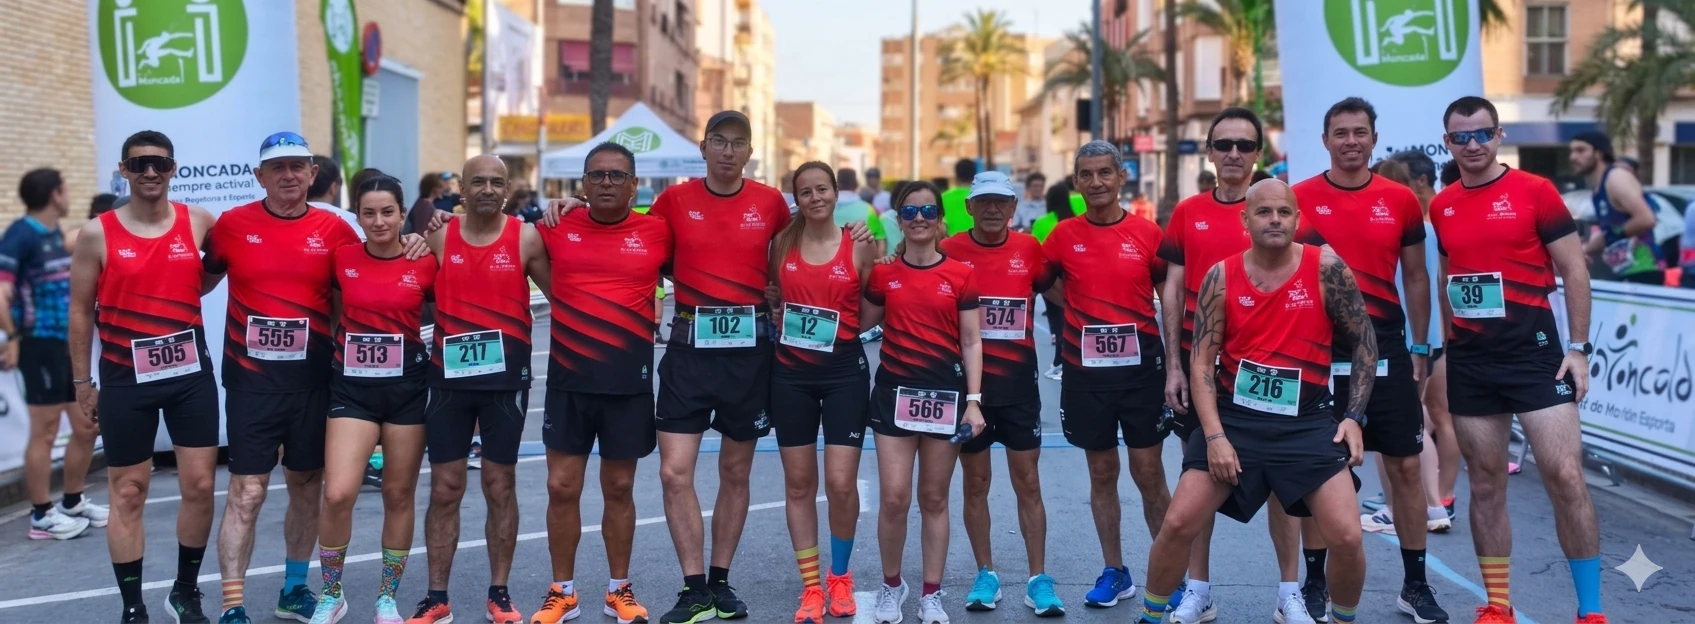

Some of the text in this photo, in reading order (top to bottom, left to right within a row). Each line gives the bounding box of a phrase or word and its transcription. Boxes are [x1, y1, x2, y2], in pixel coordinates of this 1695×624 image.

[215, 178, 254, 190] activa!
[1461, 285, 1484, 304] 39
[709, 316, 741, 334] 102
[800, 316, 818, 336] 12
[986, 307, 1015, 326] 574
[258, 327, 295, 347] 555
[1095, 335, 1127, 353] 567
[148, 344, 186, 367] 505
[356, 344, 388, 364] 513
[459, 342, 487, 363] 217
[1248, 374, 1284, 399] 216
[908, 398, 944, 420] 566
